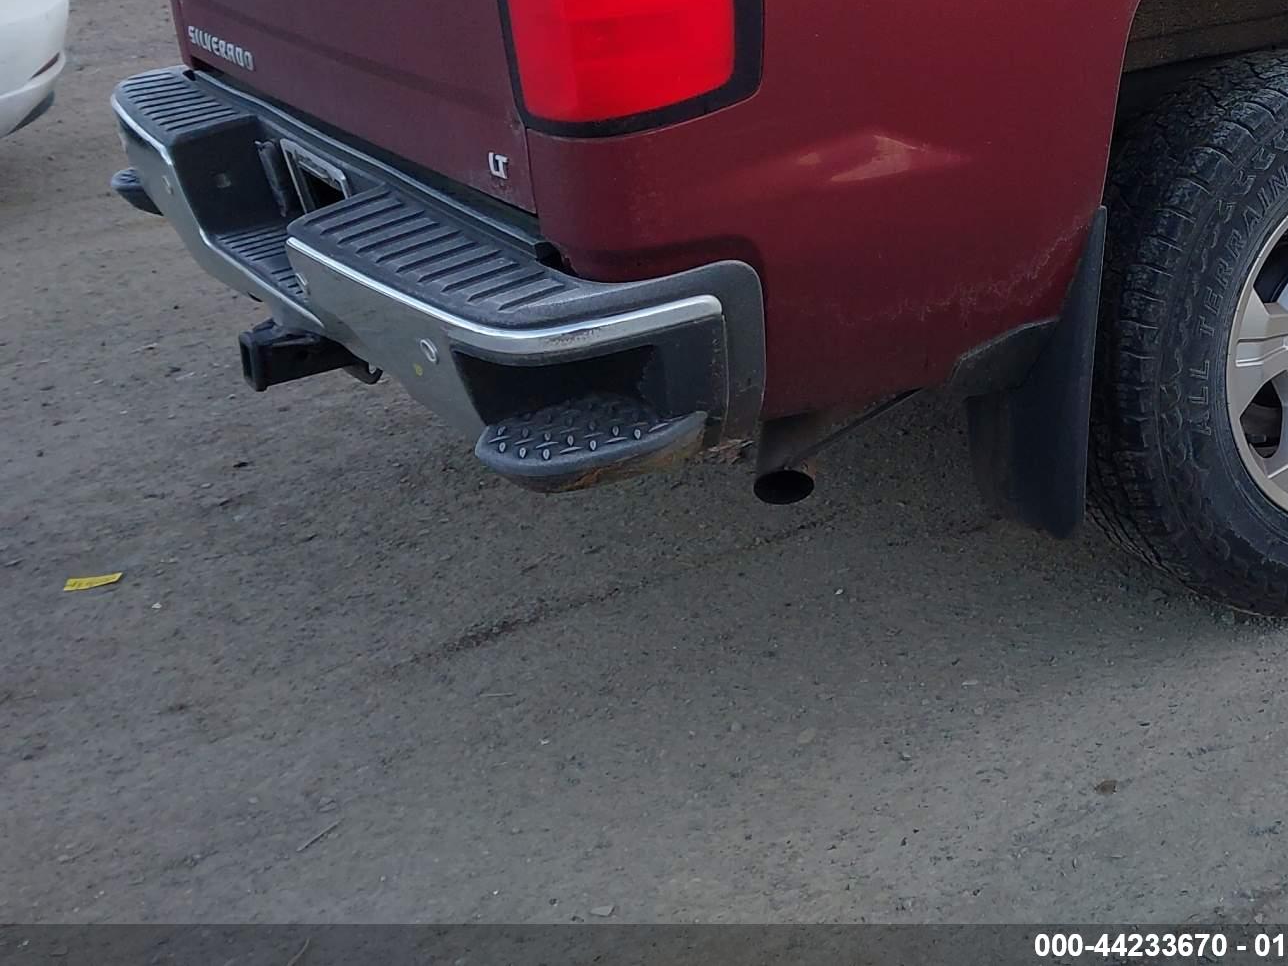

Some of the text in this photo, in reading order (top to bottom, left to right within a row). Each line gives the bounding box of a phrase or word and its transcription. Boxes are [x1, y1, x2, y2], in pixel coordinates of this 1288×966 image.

[187, 25, 255, 71] SILVERADO
[488, 151, 508, 179] LT
[1189, 359, 1213, 436] ALL
